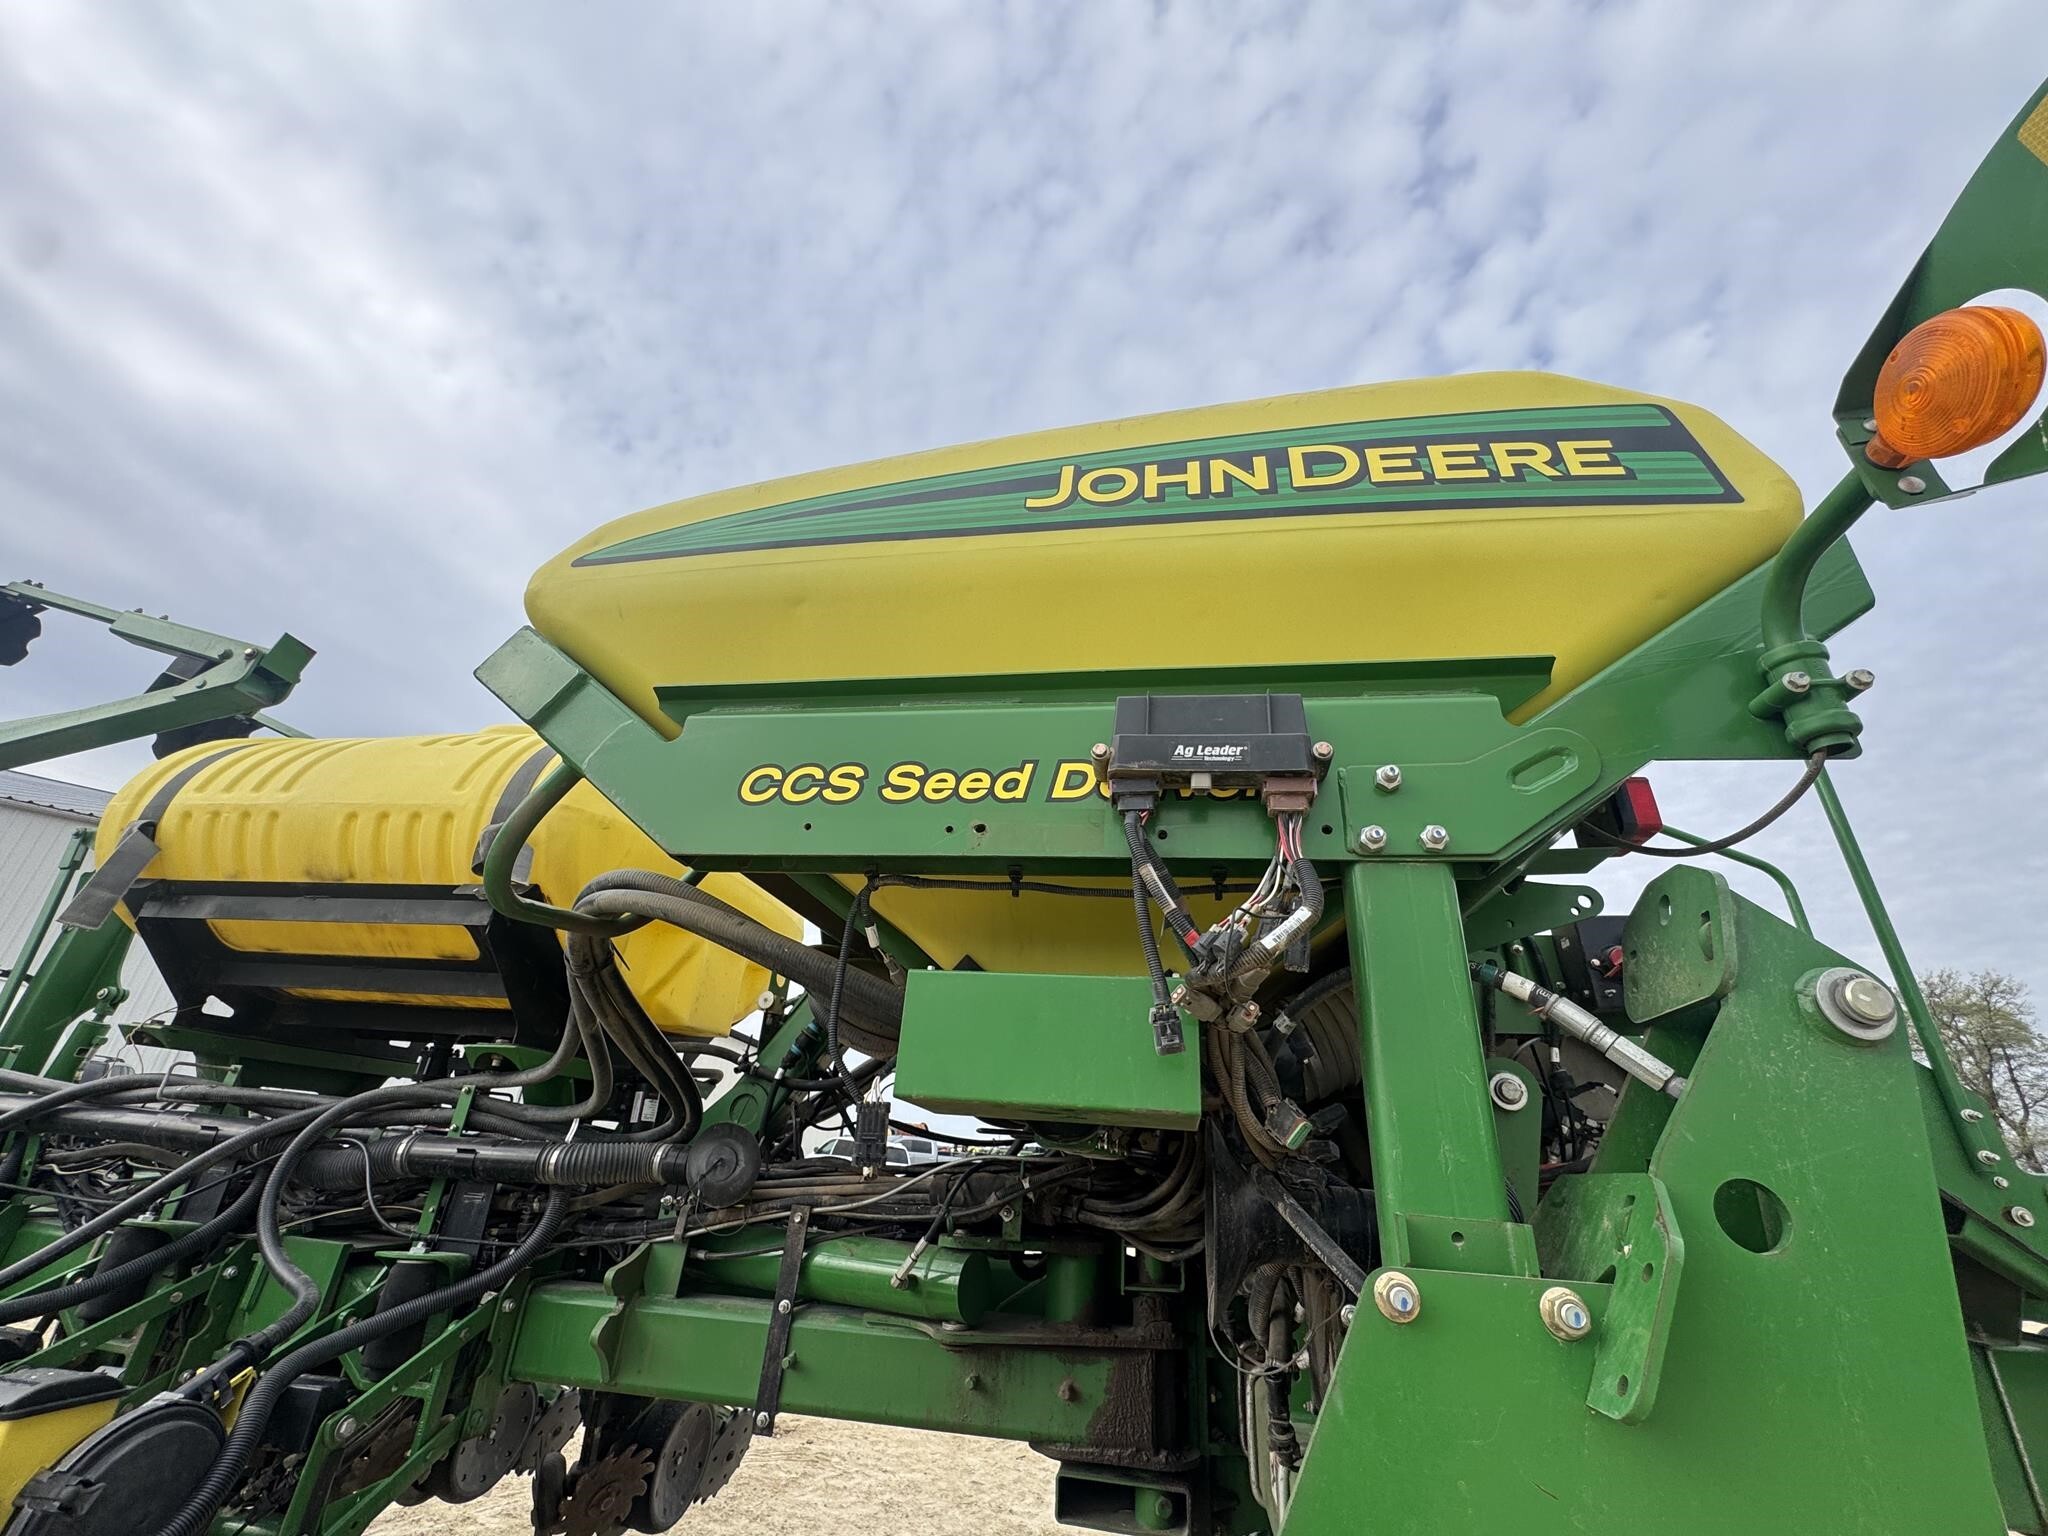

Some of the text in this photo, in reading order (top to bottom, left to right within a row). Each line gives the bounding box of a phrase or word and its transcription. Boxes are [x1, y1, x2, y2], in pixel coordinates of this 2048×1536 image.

[1025, 440, 1632, 508] JOHN DEERE
[1173, 744, 1244, 758] Ag Leader
[739, 763, 867, 803] CCS
[881, 760, 1035, 802] Seed
